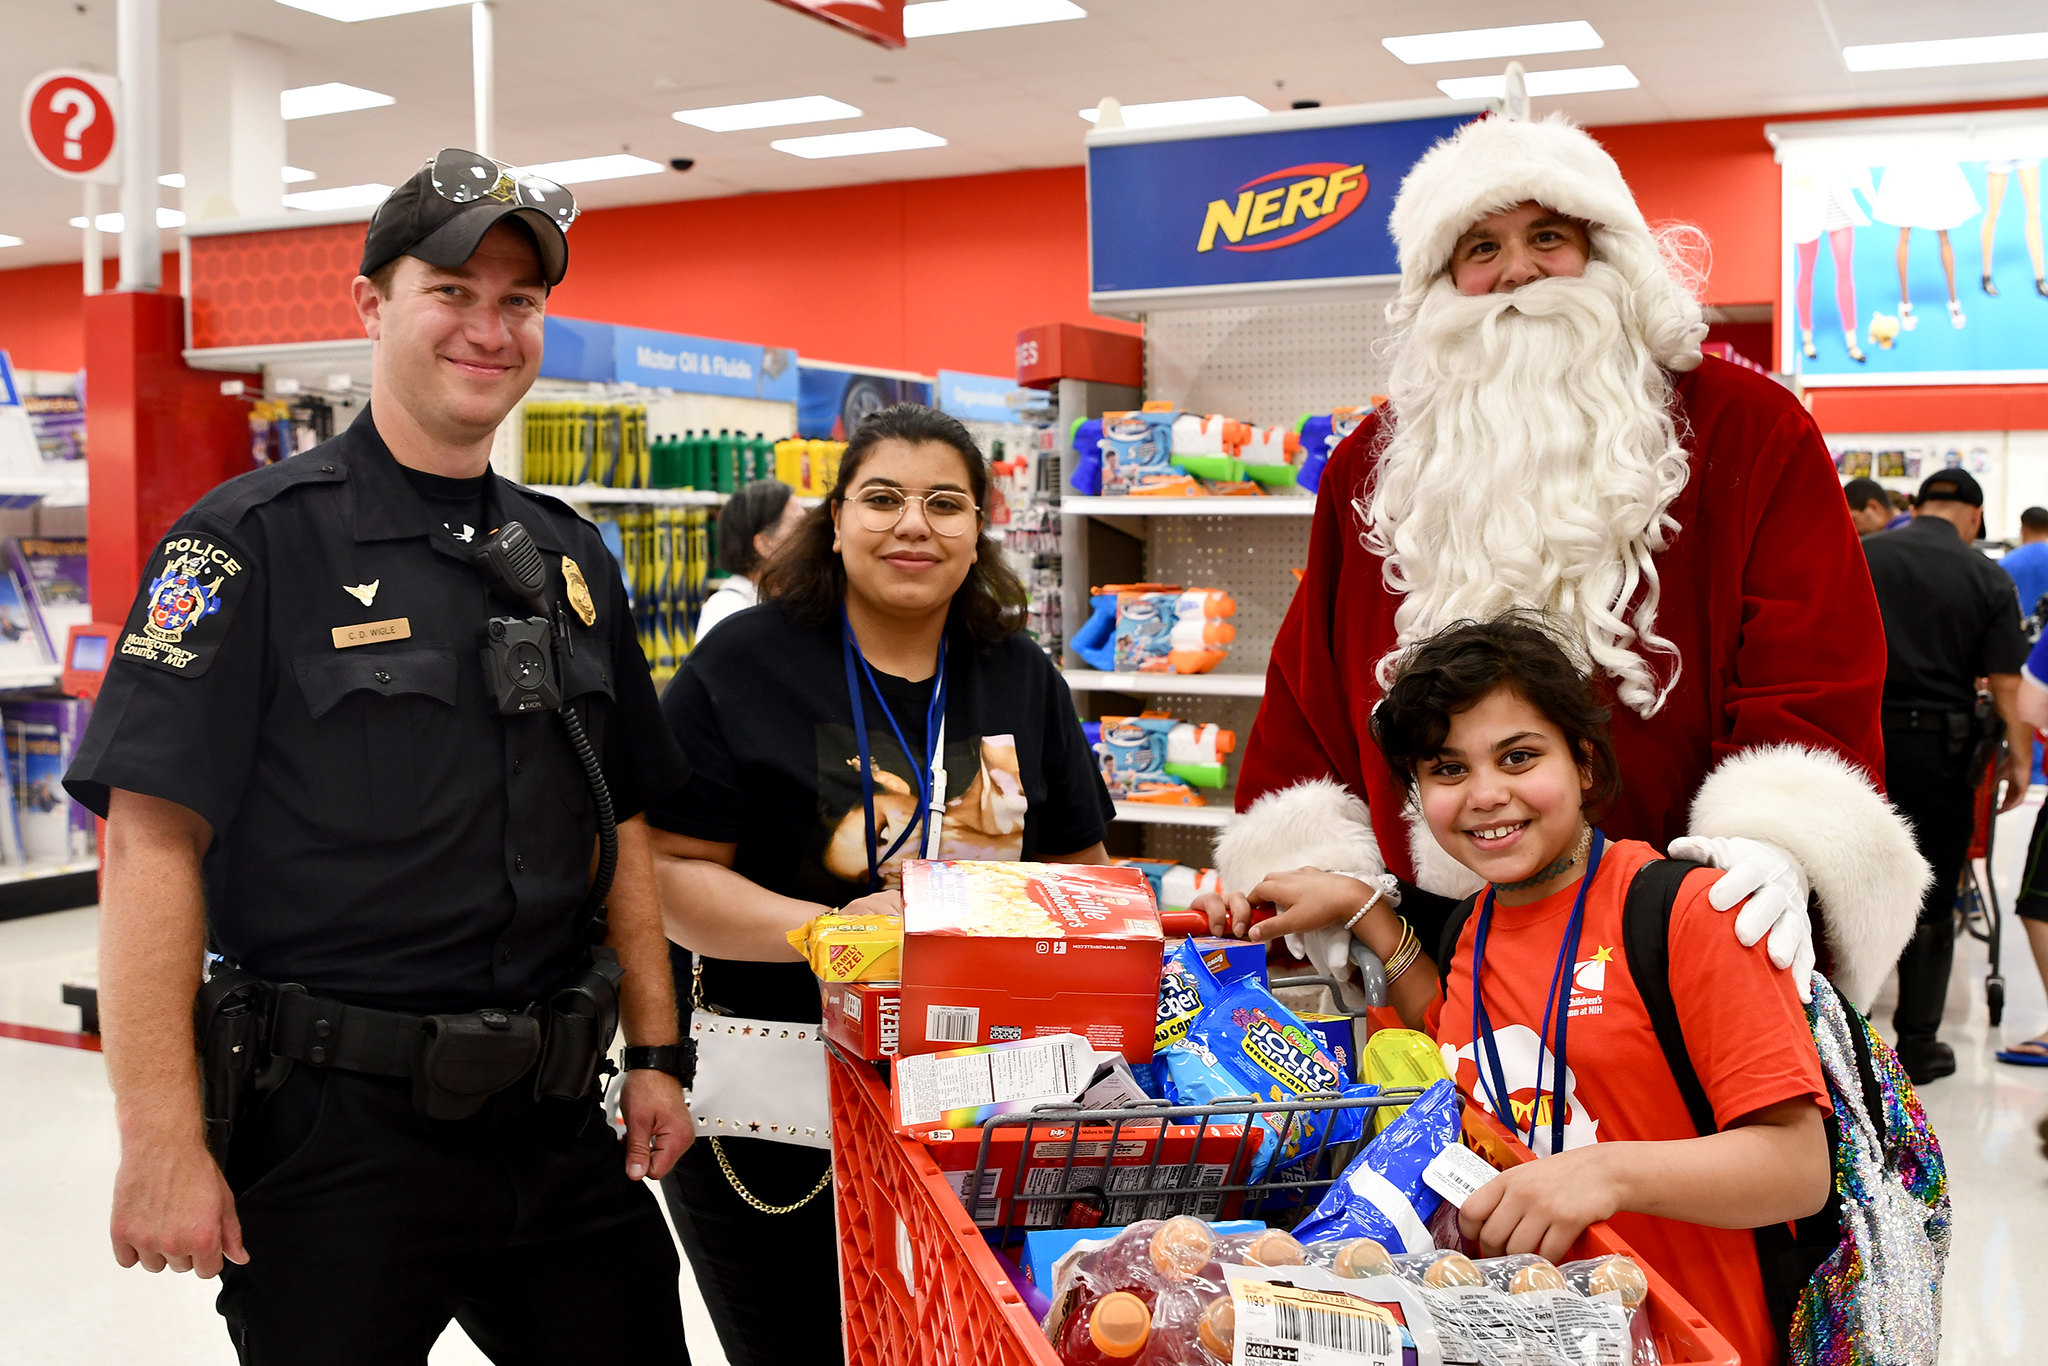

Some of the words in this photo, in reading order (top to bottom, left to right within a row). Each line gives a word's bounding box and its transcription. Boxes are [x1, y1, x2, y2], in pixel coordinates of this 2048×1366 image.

[1197, 164, 1364, 253] NERF
[637, 346, 677, 371] Motor
[679, 352, 699, 374] Oil
[701, 354, 711, 375] &
[713, 355, 752, 380] Fluids
[164, 538, 242, 576] POLICE
[348, 632, 357, 640] C.
[359, 630, 368, 639] D.
[369, 625, 396, 637] WIGLE
[124, 633, 198, 662] Montgomery
[162, 653, 188, 669] MD
[832, 944, 858, 972] FAMILY
[837, 950, 864, 978] SIZE!
[1580, 1007, 1588, 1016] at
[1589, 1005, 1603, 1015] NIH
[1245, 1043, 1278, 1073] HARD
[1251, 1023, 1333, 1084] JOLLY
[1251, 1035, 1324, 1093] ranche
[934, 1131, 940, 1139] 8
[1245, 1294, 1265, 1308] 1193
[1302, 1291, 1354, 1307] CONVEYABLE
[1535, 1312, 1552, 1321] Facts
